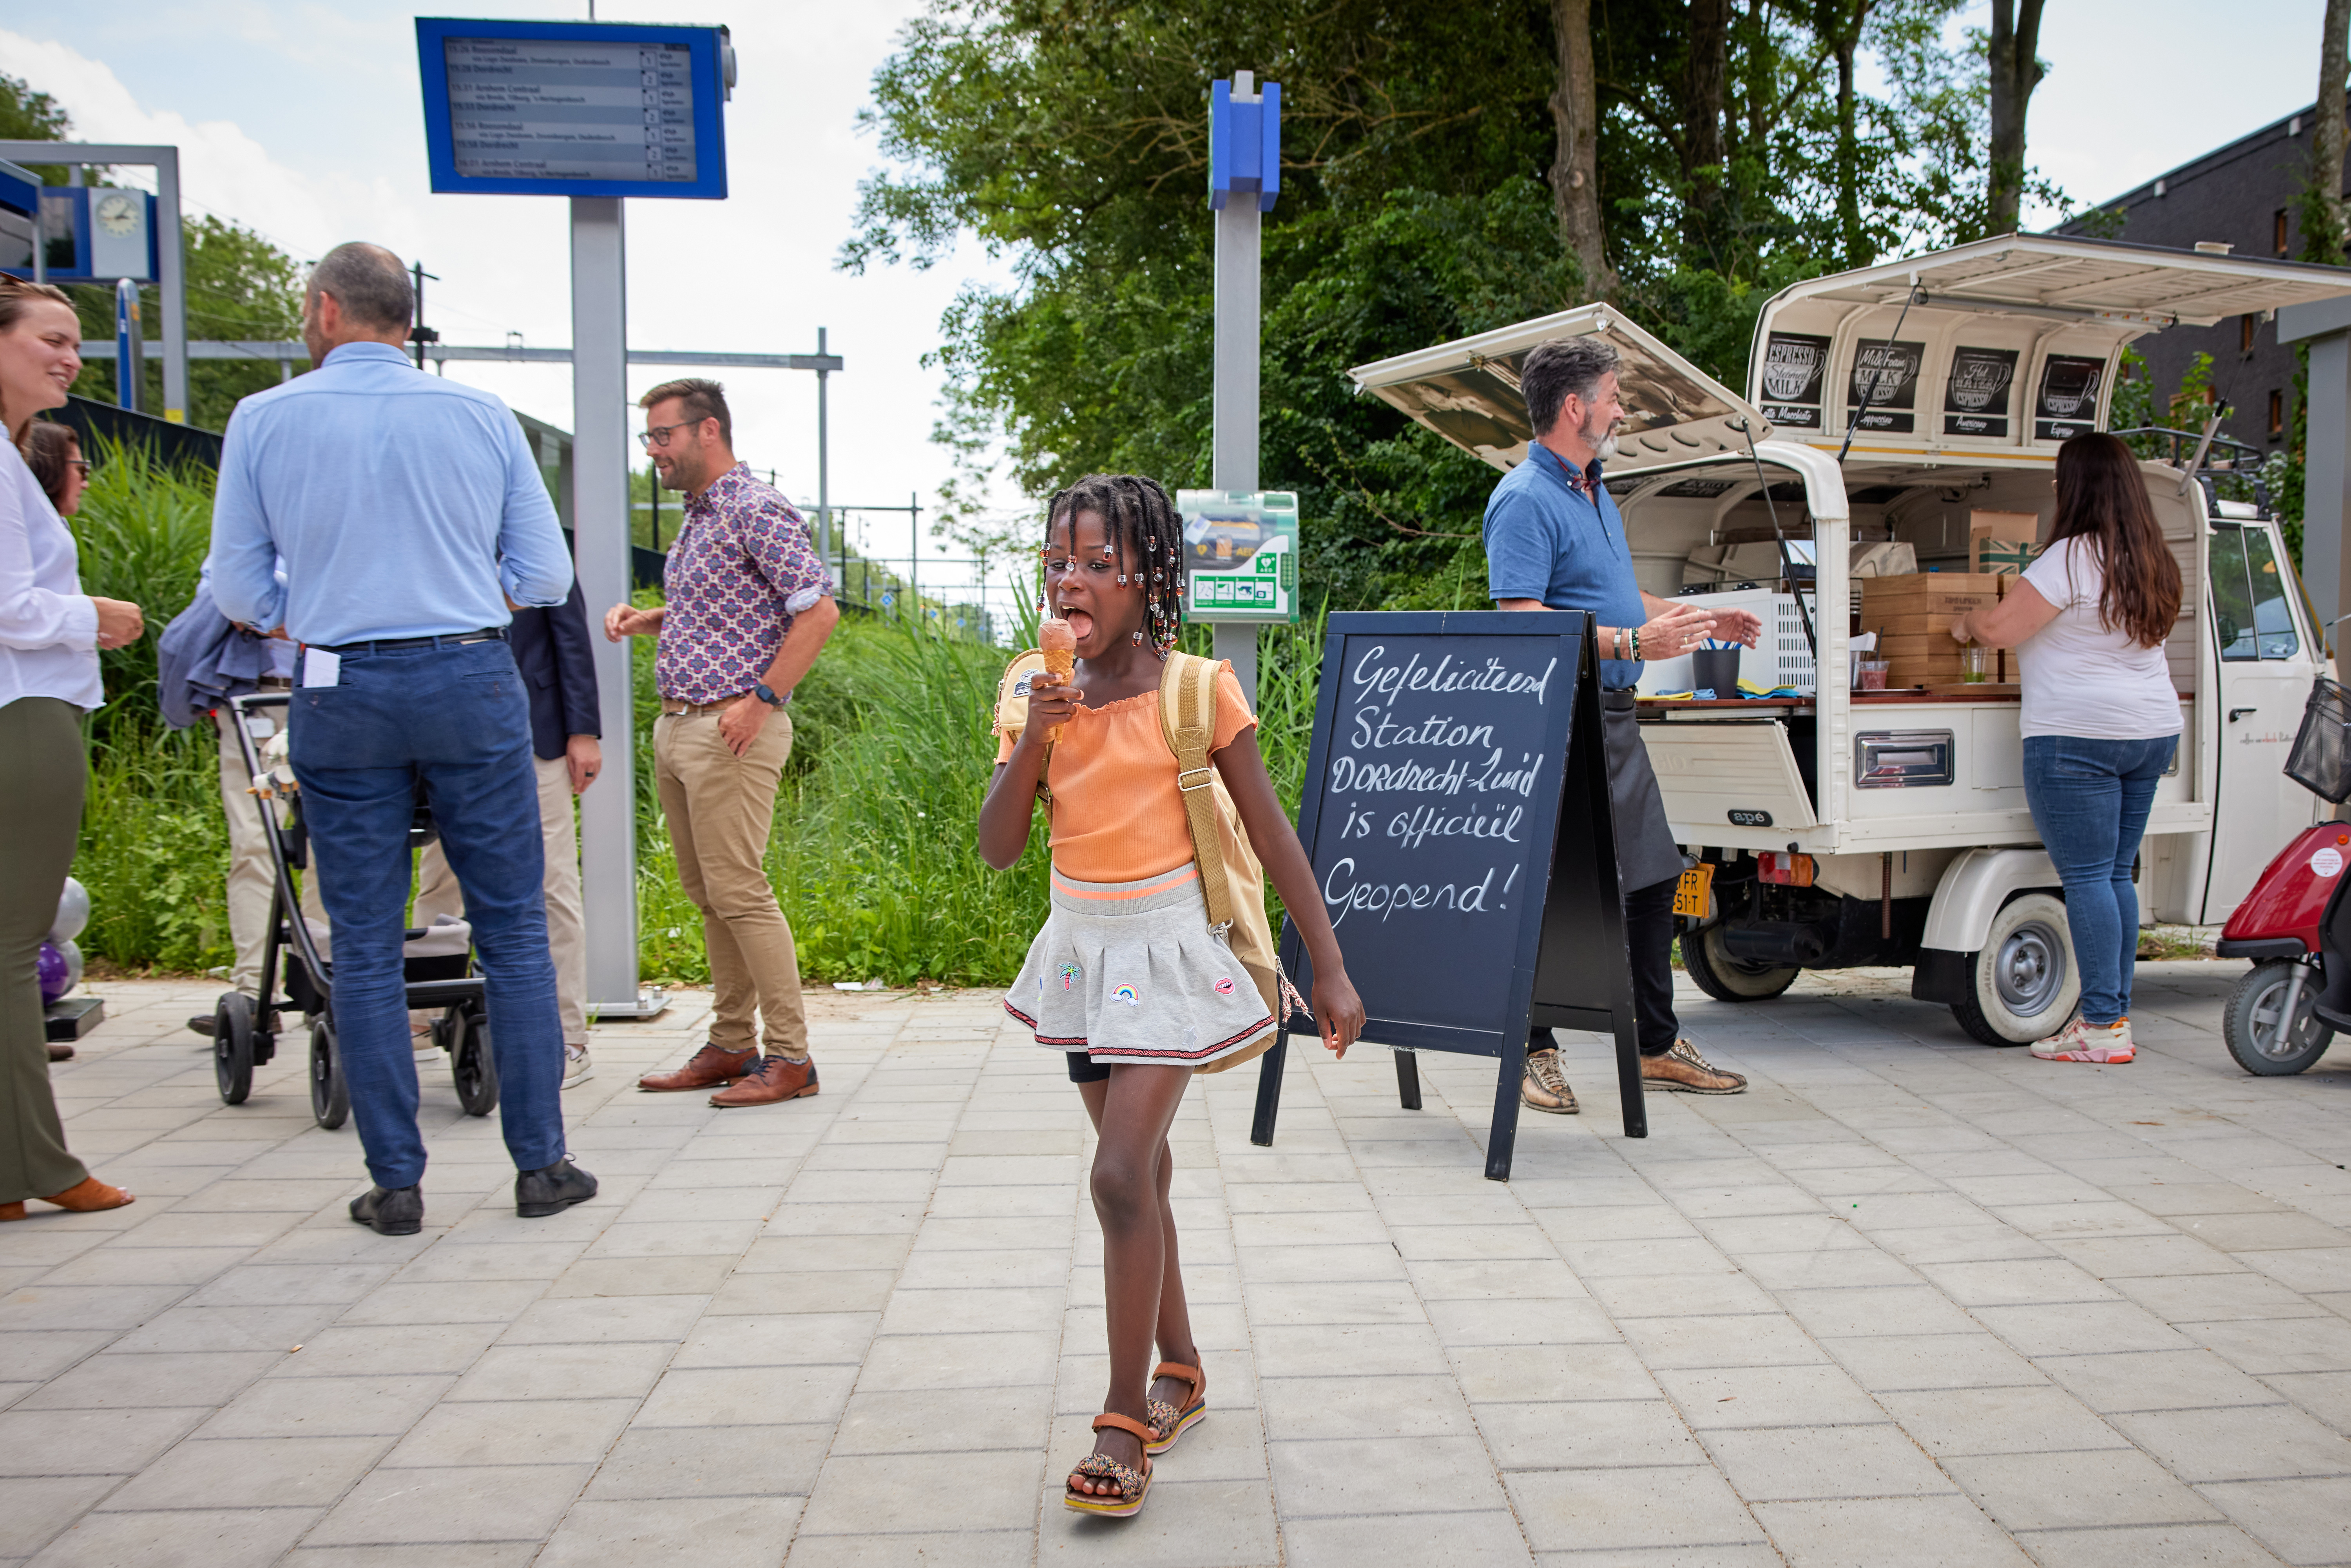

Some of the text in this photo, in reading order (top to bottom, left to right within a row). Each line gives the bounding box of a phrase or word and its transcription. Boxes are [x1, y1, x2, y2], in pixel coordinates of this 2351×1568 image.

[1768, 344, 1815, 364] ESPRESSO
[1883, 351, 1905, 368] Foam
[1766, 364, 1810, 379] Steamed
[1860, 370, 1897, 384] MK
[1963, 363, 1989, 378] Hot
[1768, 378, 1804, 395] MILK
[1955, 377, 1994, 391] WATER
[1956, 391, 1989, 407] ESPRESSO
[2047, 398, 2079, 413] ESPRESSO
[1778, 406, 1812, 421] Macchiato
[1860, 414, 1893, 427] appuccino
[1956, 415, 1988, 429] Americano
[1353, 646, 1557, 706] Gefeliciteerd
[1351, 706, 1494, 749] Station
[1341, 801, 1375, 839] is
